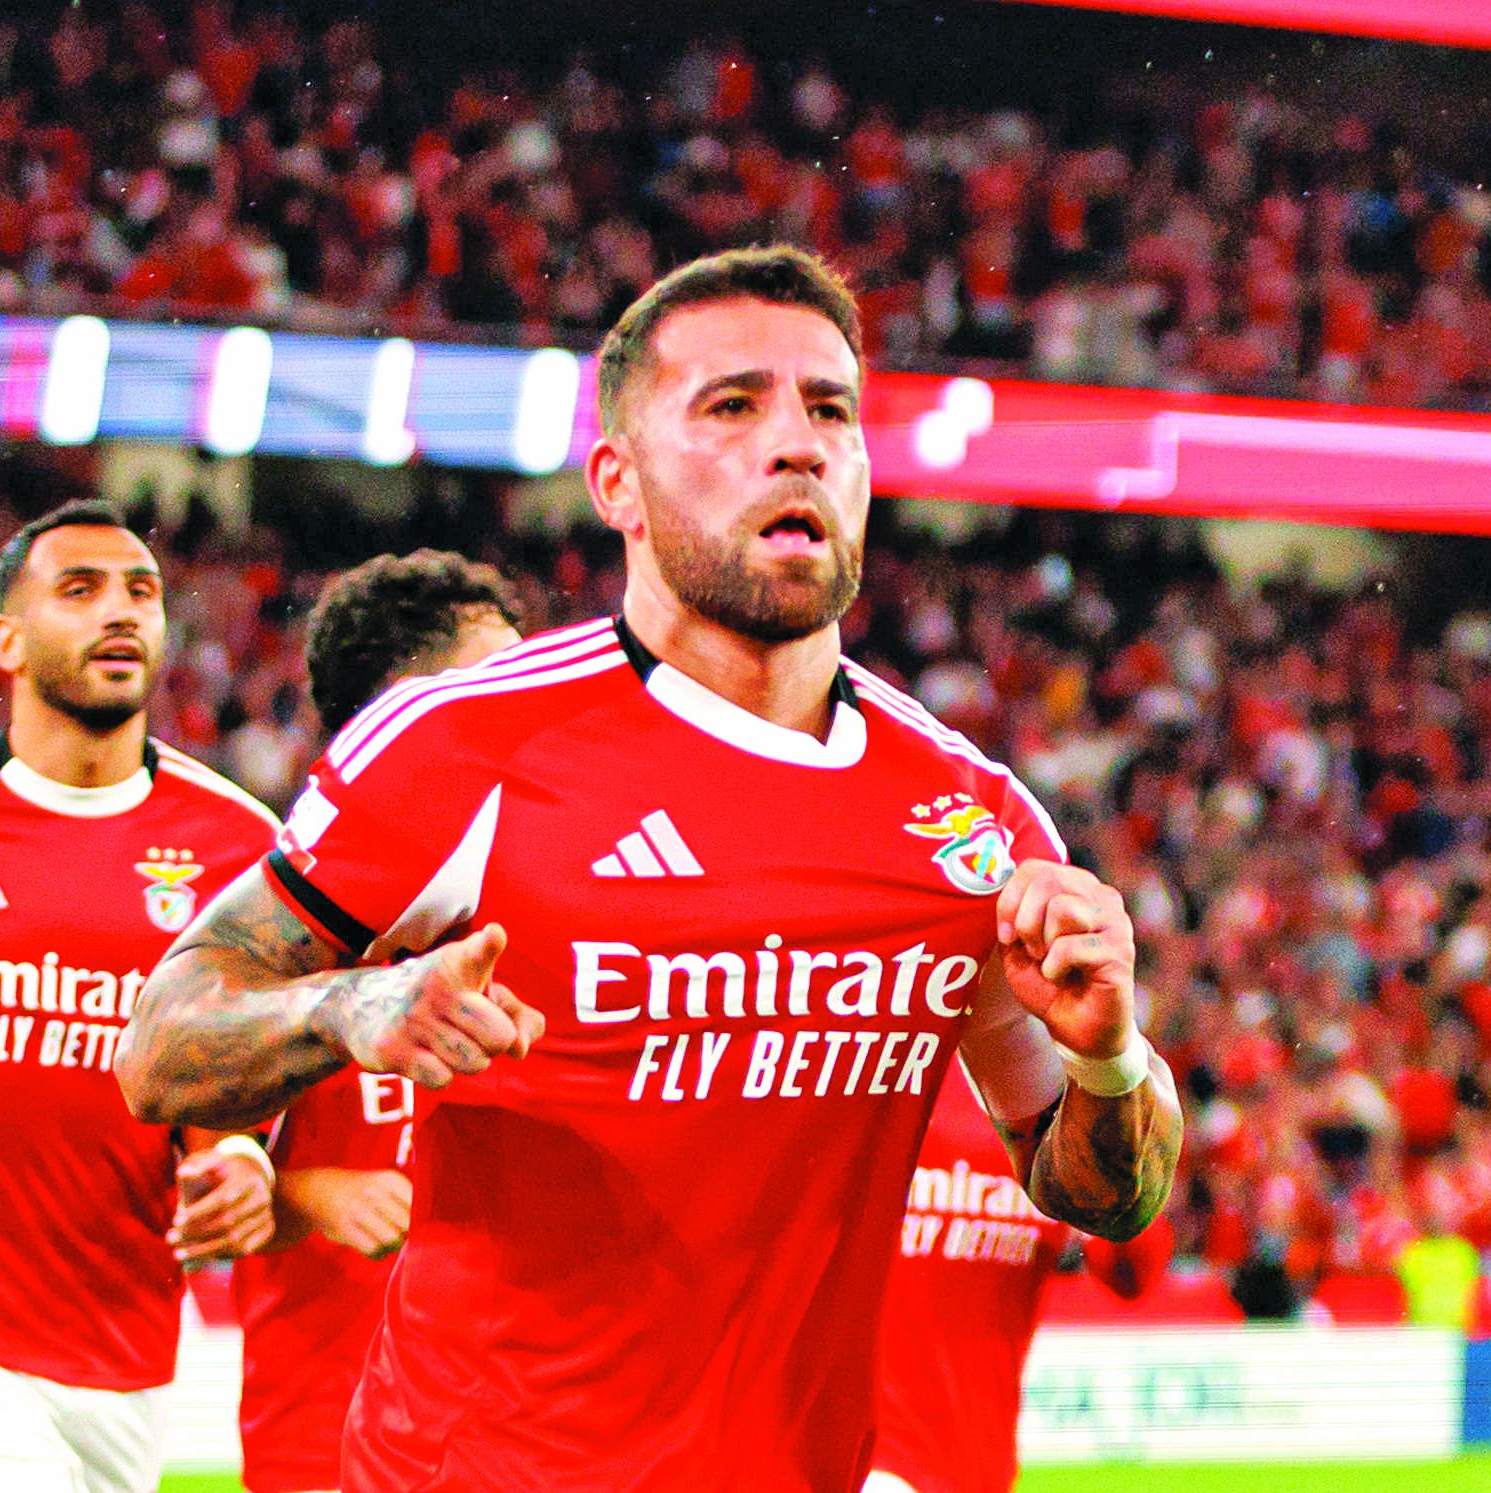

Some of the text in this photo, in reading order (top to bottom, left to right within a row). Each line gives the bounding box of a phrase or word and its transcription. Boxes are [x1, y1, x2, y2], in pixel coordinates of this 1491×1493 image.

[571, 933, 981, 1025] Emirate
[39, 1019, 122, 1073] BETT
[628, 1030, 940, 1102] FLY BETTER
[907, 1159, 1034, 1220] mira
